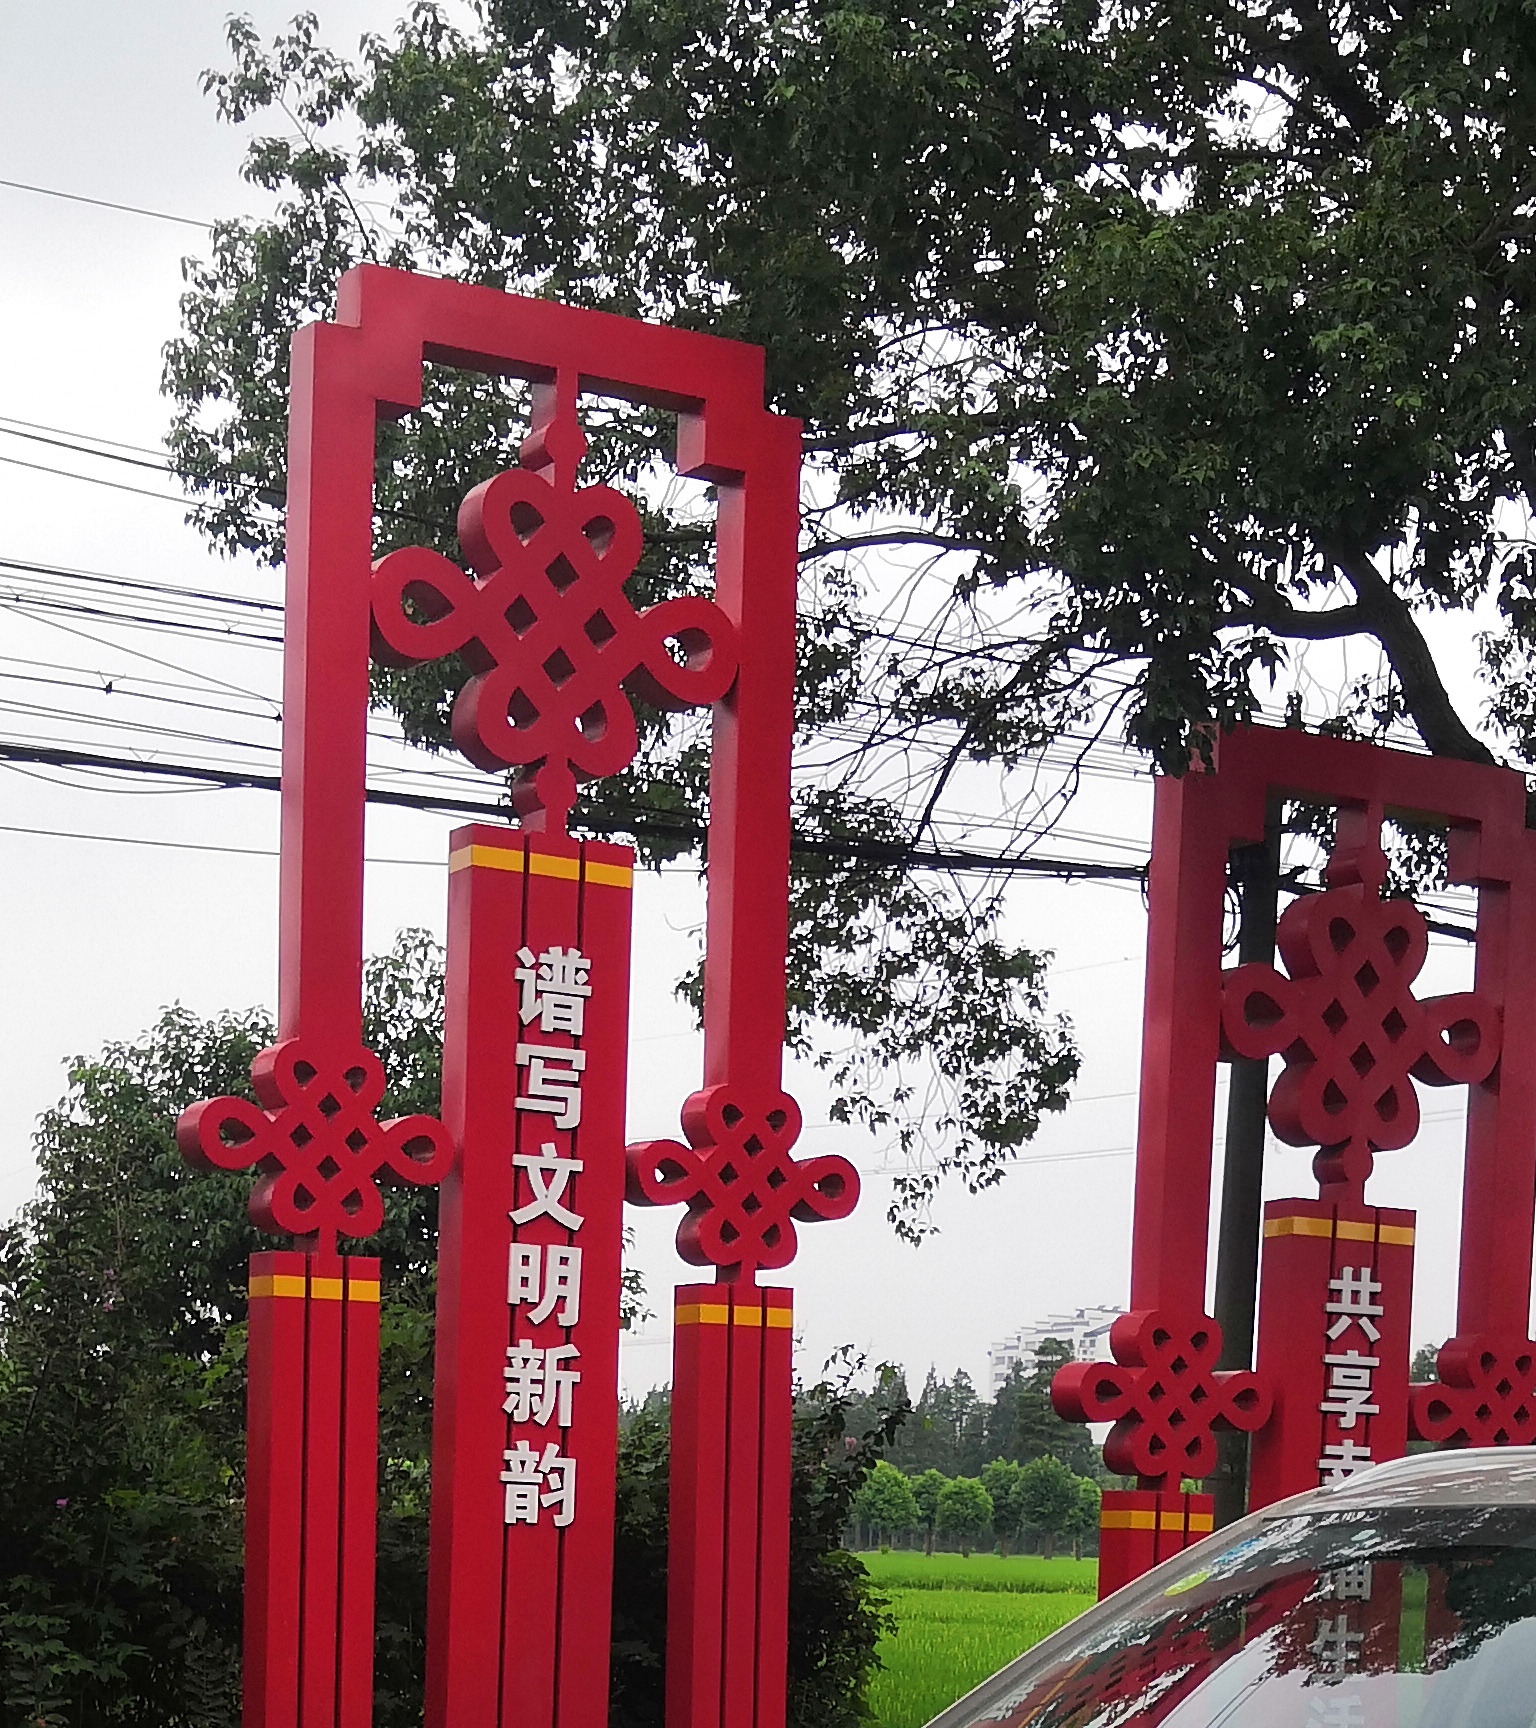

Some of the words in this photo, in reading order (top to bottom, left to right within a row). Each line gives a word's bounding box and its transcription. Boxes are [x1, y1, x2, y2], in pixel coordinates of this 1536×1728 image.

[500, 946, 593, 1527] 谱写文明新韵
